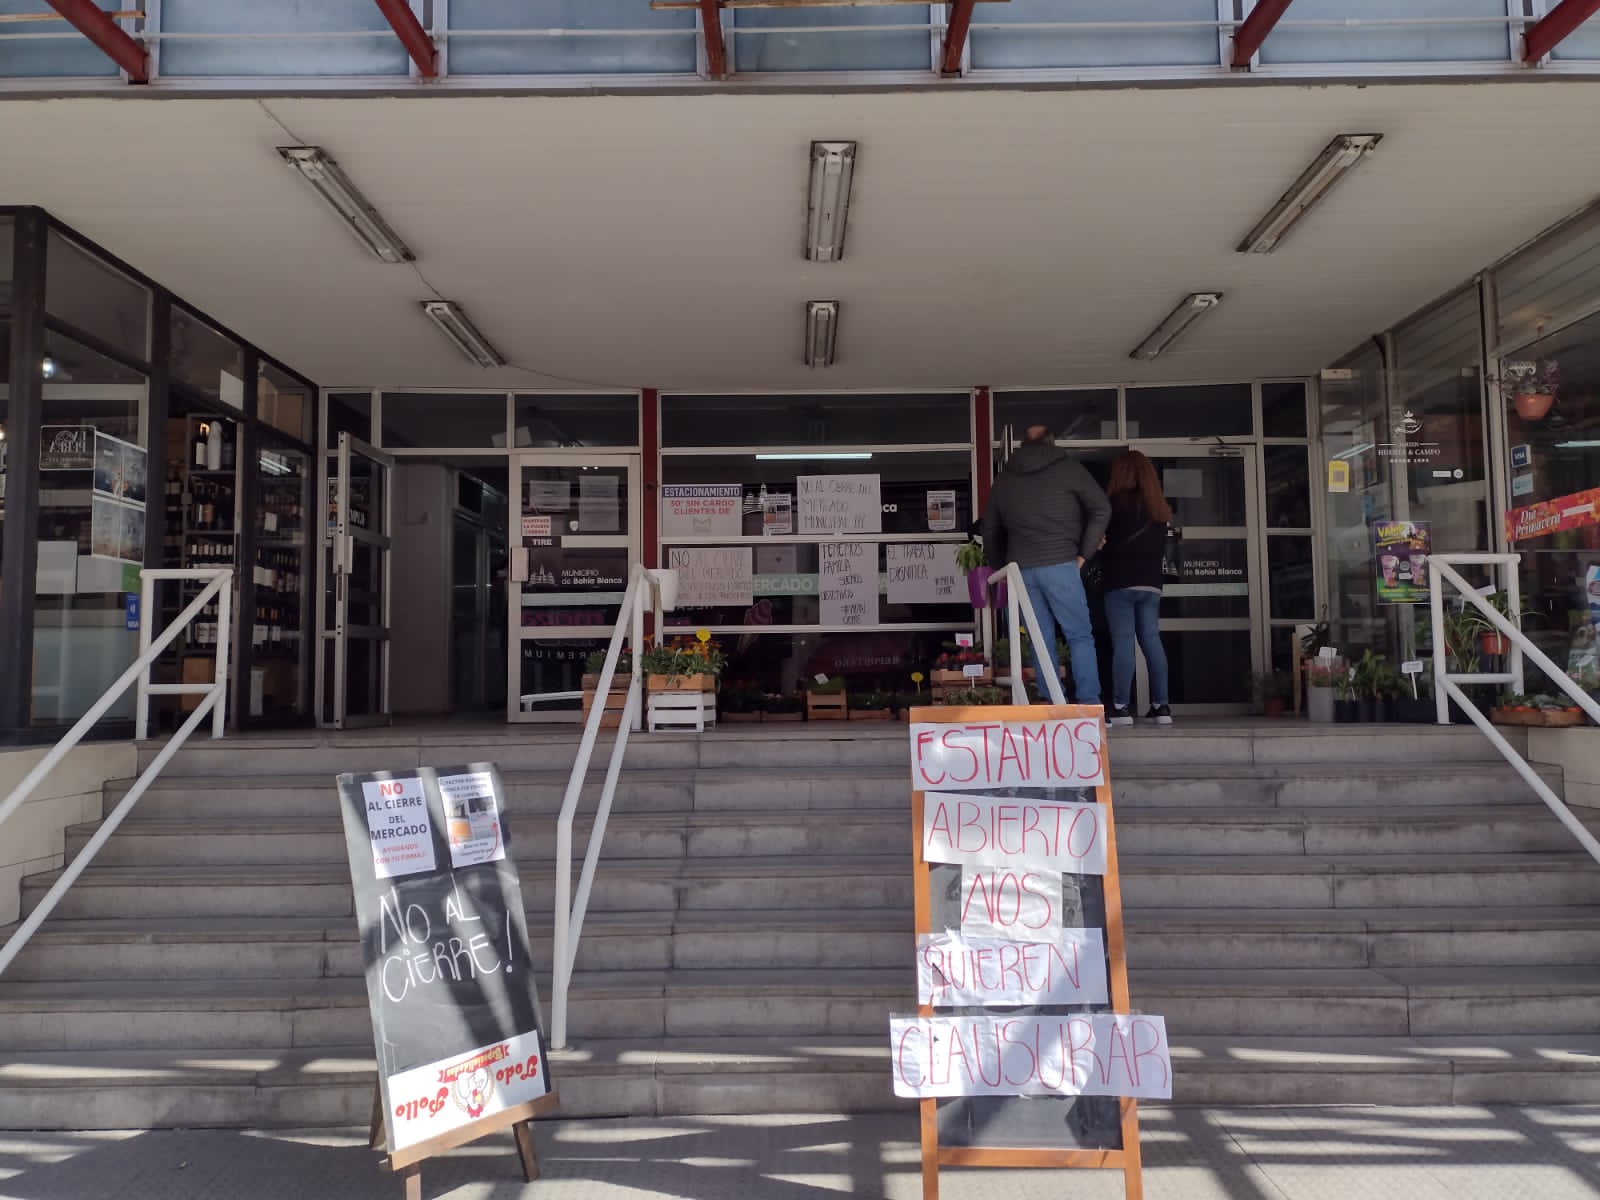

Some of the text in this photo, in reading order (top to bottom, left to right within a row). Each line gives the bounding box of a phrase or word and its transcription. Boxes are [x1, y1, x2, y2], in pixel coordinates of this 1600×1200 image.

[1414, 448, 1441, 456] CAMPO
[664, 487, 740, 497] ESTACIONAMIENTO
[686, 499, 700, 507] SIN
[702, 499, 736, 507] CARGO
[673, 507, 732, 515] CLIENTES DE
[532, 538, 553, 546] TIRE
[671, 550, 690, 568] NO
[561, 569, 599, 577] MUNICIPIO
[1183, 568, 1194, 576] de
[1217, 568, 1243, 576] Blanca
[561, 577, 571, 585] de
[753, 578, 814, 591] ERCADO
[917, 721, 1101, 784] ESTAMOS
[379, 782, 403, 796] NO
[368, 796, 423, 811] AL CIERRE
[388, 815, 406, 825] DEL
[370, 824, 428, 841] MERCADO
[928, 801, 1098, 858] ABIERTO
[962, 872, 1051, 929] NOS
[380, 872, 481, 954] NO AL
[923, 941, 1080, 1000] QUIEREN
[899, 1019, 1168, 1089] CLAUSURAR
[496, 1055, 538, 1085] Todo
[395, 1087, 449, 1120] Pollo
